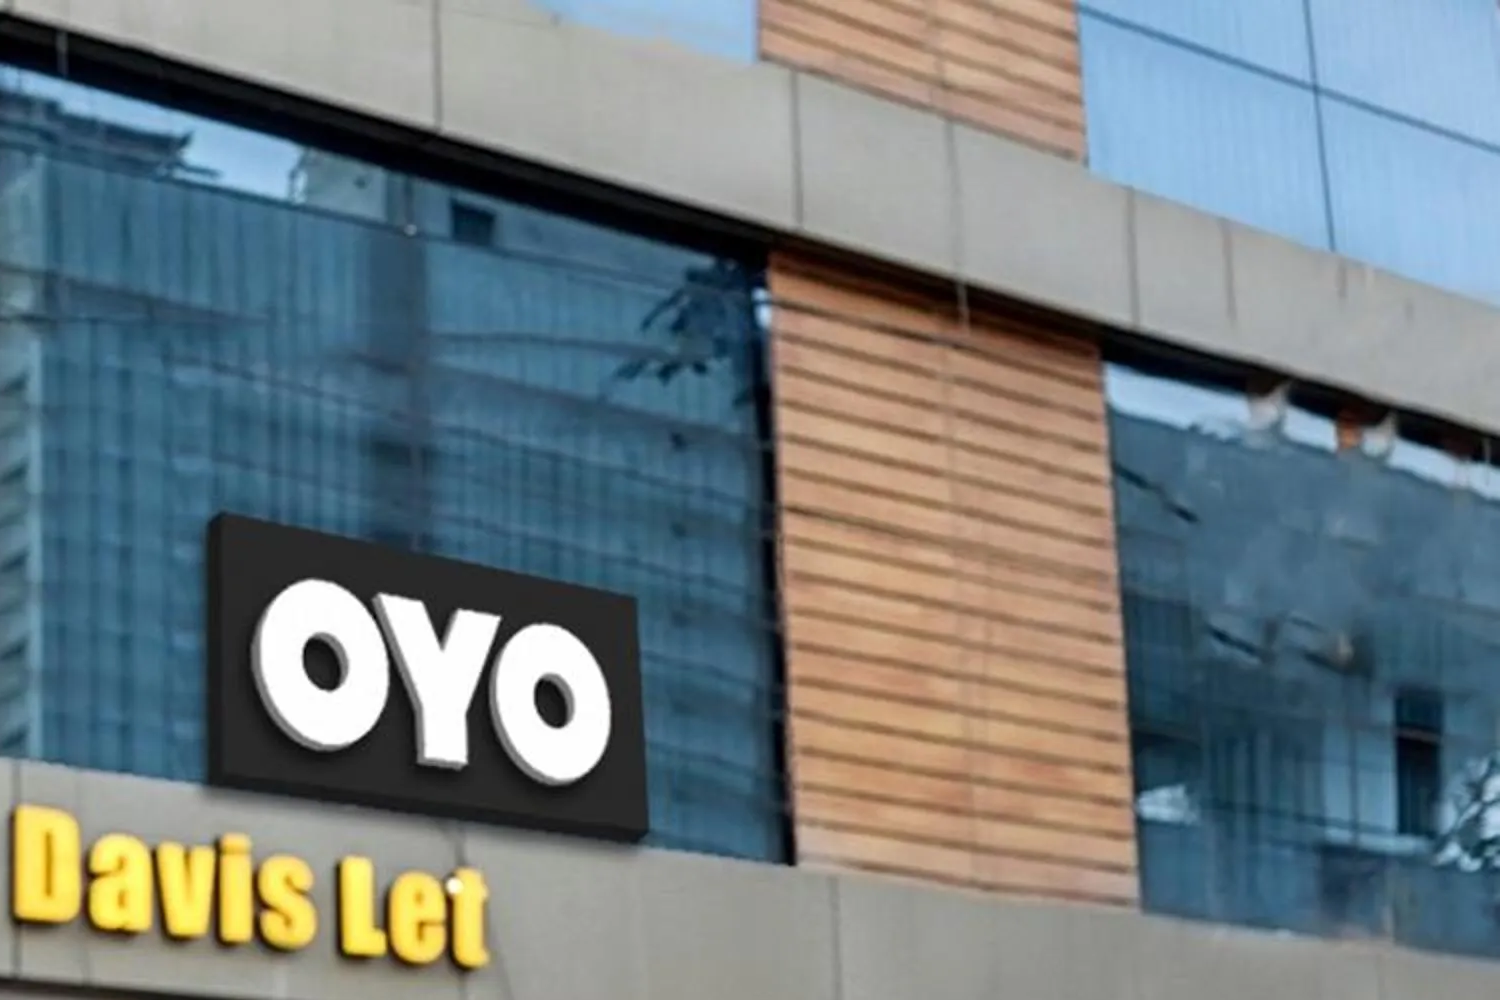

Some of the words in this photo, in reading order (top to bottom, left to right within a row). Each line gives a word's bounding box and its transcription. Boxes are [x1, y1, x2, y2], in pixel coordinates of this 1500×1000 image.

[250, 578, 612, 786] OYO
[11, 804, 318, 951] Davis
[338, 855, 489, 970] Let
